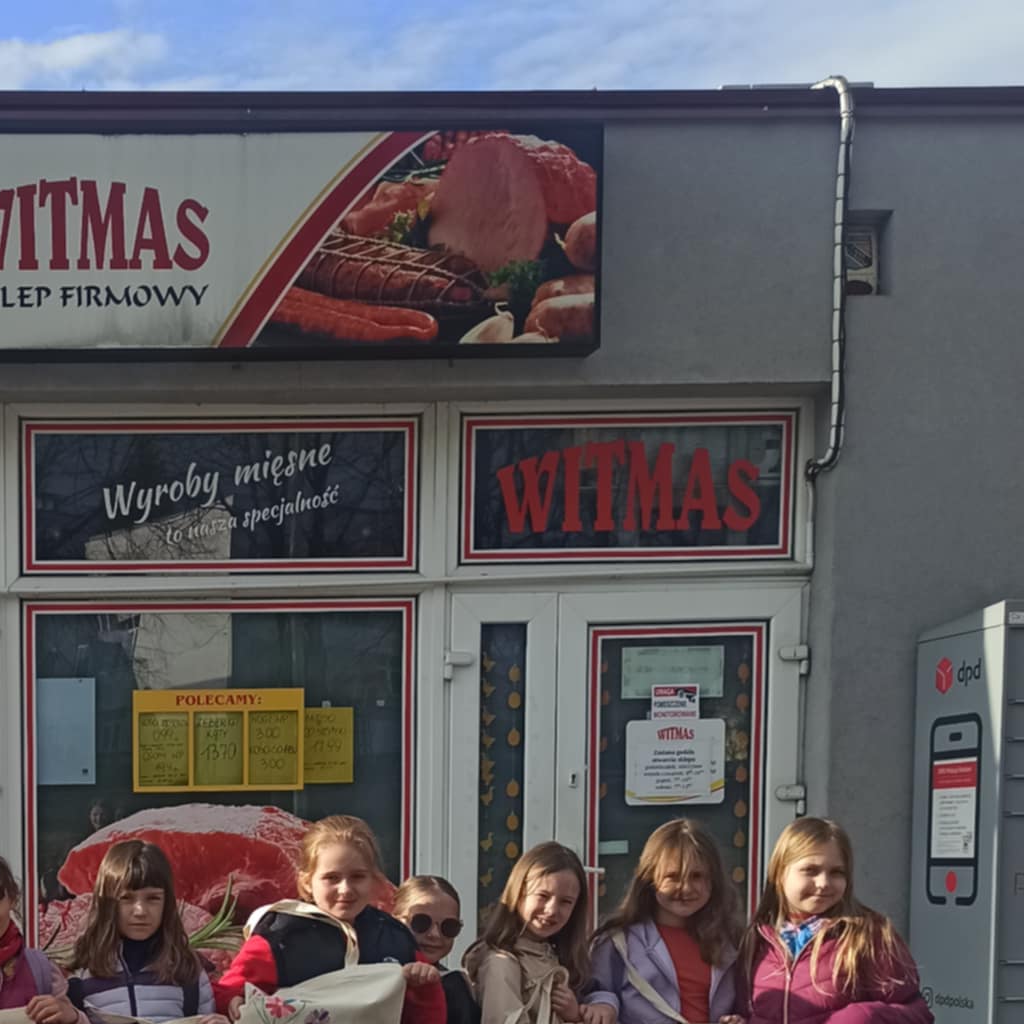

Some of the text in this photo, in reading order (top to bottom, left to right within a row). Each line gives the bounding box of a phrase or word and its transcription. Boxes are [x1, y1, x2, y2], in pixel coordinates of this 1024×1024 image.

[60, 284, 210, 308] FIRMOWY
[102, 443, 333, 524] Wyroby mięsne
[496, 438, 761, 534] WITMAS
[166, 484, 340, 545] to nasza specjalność
[957, 657, 982, 688] dpd
[176, 694, 262, 706] POLECAMY:
[657, 726, 695, 740] WITMAS
